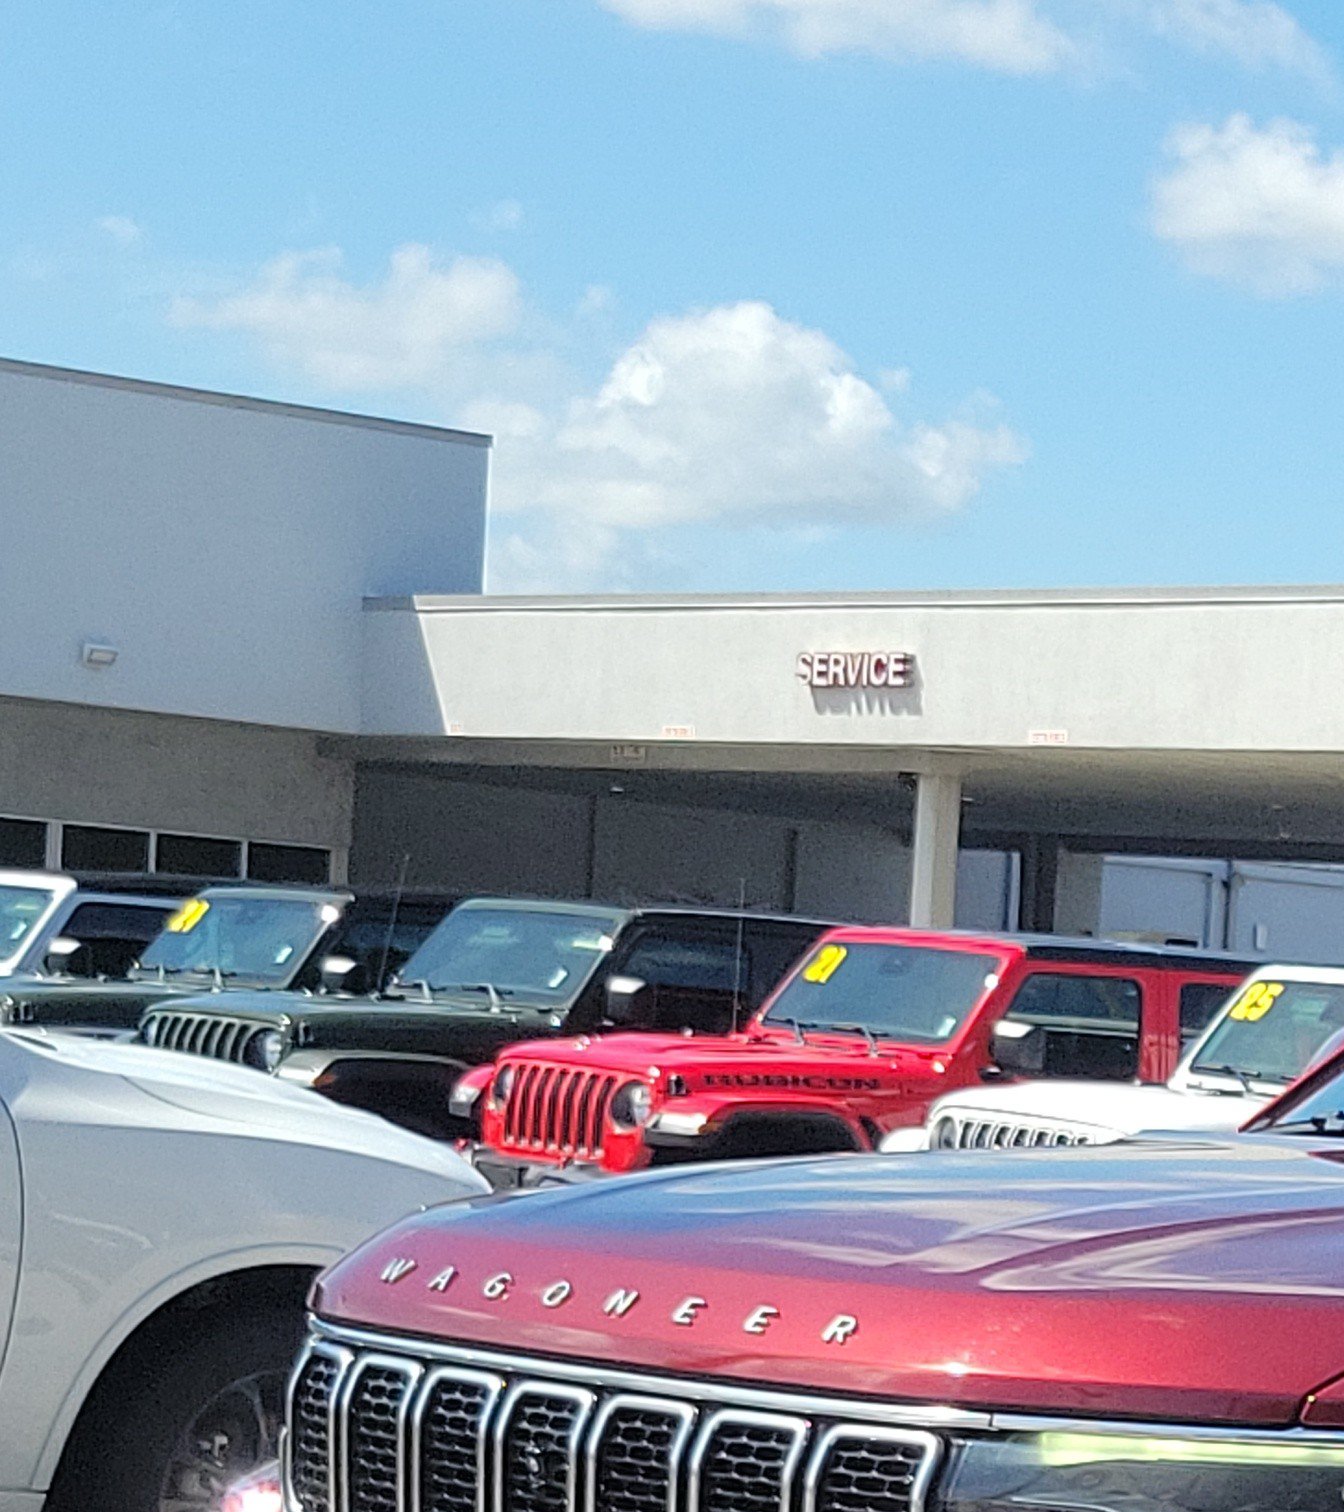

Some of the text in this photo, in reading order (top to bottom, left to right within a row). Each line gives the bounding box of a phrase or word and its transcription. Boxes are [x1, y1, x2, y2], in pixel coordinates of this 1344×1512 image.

[796, 652, 907, 688] SERVICE
[704, 1074, 881, 1090] RUBICON
[379, 1257, 860, 1345] WAGONEER
